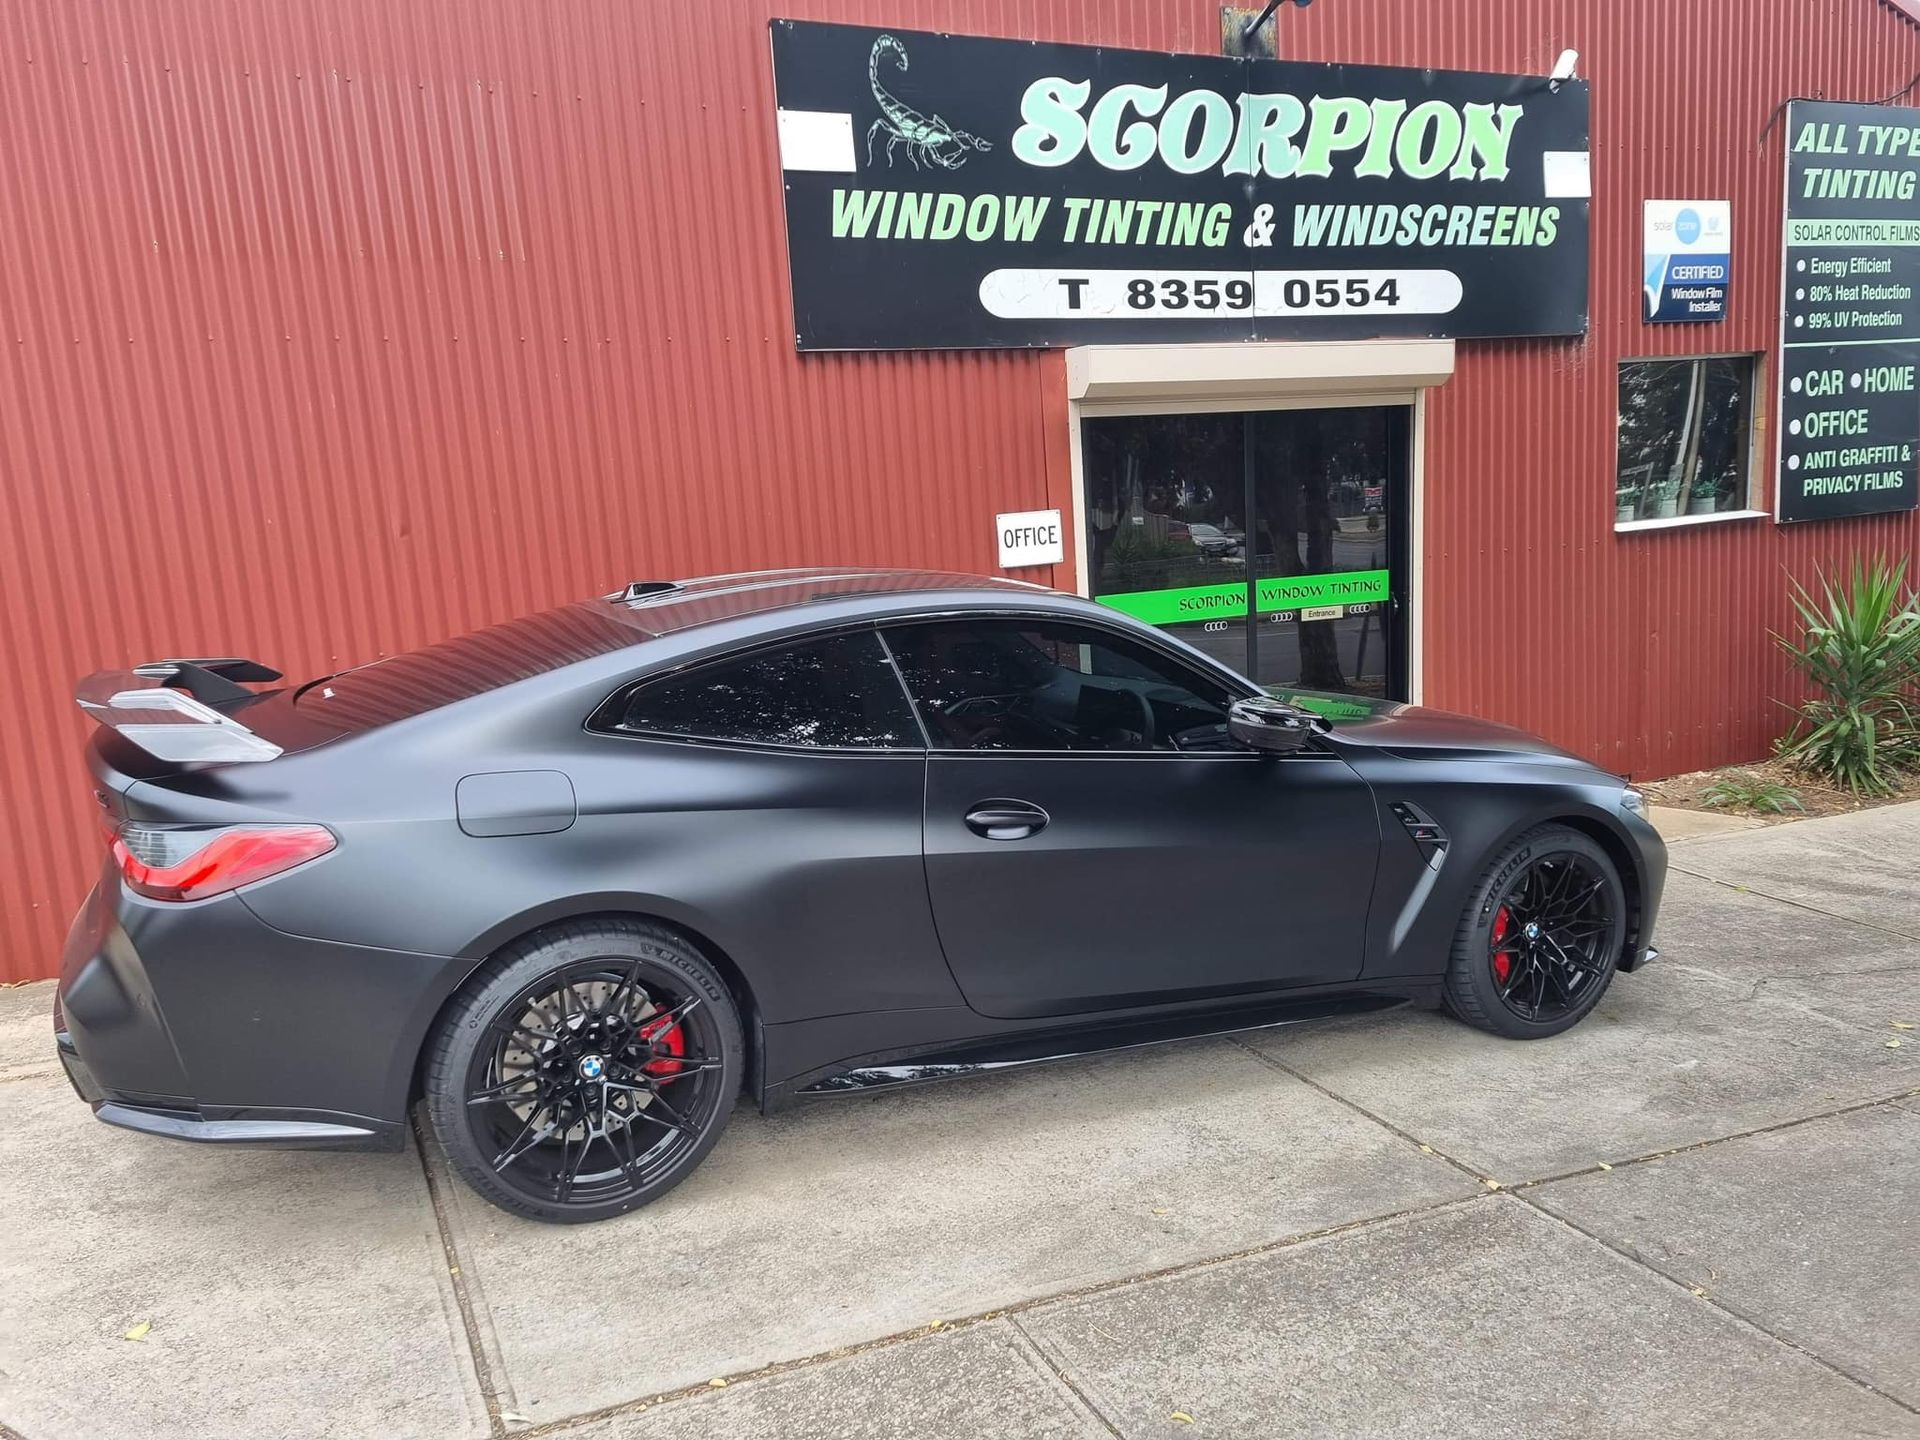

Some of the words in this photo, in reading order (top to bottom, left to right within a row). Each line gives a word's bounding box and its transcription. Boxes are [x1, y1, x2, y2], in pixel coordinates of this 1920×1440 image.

[1011, 76, 1525, 182] SCORPION
[1793, 122, 1849, 154] ALL
[1802, 168, 1917, 200] TINTING
[831, 188, 1051, 243] WINDOW
[1063, 197, 1232, 248] TINTING
[1243, 203, 1276, 248] &
[1292, 203, 1560, 248] WINDSCREENS
[1794, 224, 1832, 241] SOLAR
[1835, 224, 1888, 241] CONTROL
[1890, 225, 1920, 241] FILMS
[1671, 265, 1724, 279] CERTIFIED
[1811, 258, 1848, 277] Energy
[1851, 257, 1891, 274] Efficient
[1058, 279, 1090, 309] T
[1127, 279, 1252, 310] 8359
[1283, 278, 1400, 308] 0554
[1671, 287, 1706, 300] Window
[1706, 286, 1723, 299] Film
[1810, 286, 1832, 302] 80%
[1835, 285, 1859, 301] Heat
[1862, 283, 1911, 300] Reduction
[1689, 301, 1721, 312] Installer
[1809, 313, 1832, 329] 99%
[1834, 312, 1850, 328] UV
[1852, 310, 1902, 327] Protection
[1805, 369, 1844, 397] CAR
[1864, 366, 1915, 393] HOME
[1804, 409, 1869, 438] OFFICE
[1803, 450, 1837, 470] ANTI
[1840, 445, 1898, 467] GRAFFITI
[1901, 444, 1911, 462] &
[1803, 474, 1862, 497] PRIVACY
[1864, 470, 1903, 491] FILMS
[1003, 525, 1058, 548] OFFICE
[1179, 592, 1246, 612] SCORPION
[1261, 583, 1326, 601] WINDOW
[1330, 579, 1382, 595] TINTING
[1308, 608, 1336, 618] Entrance
[659, 949, 721, 1001] MICHELIN
